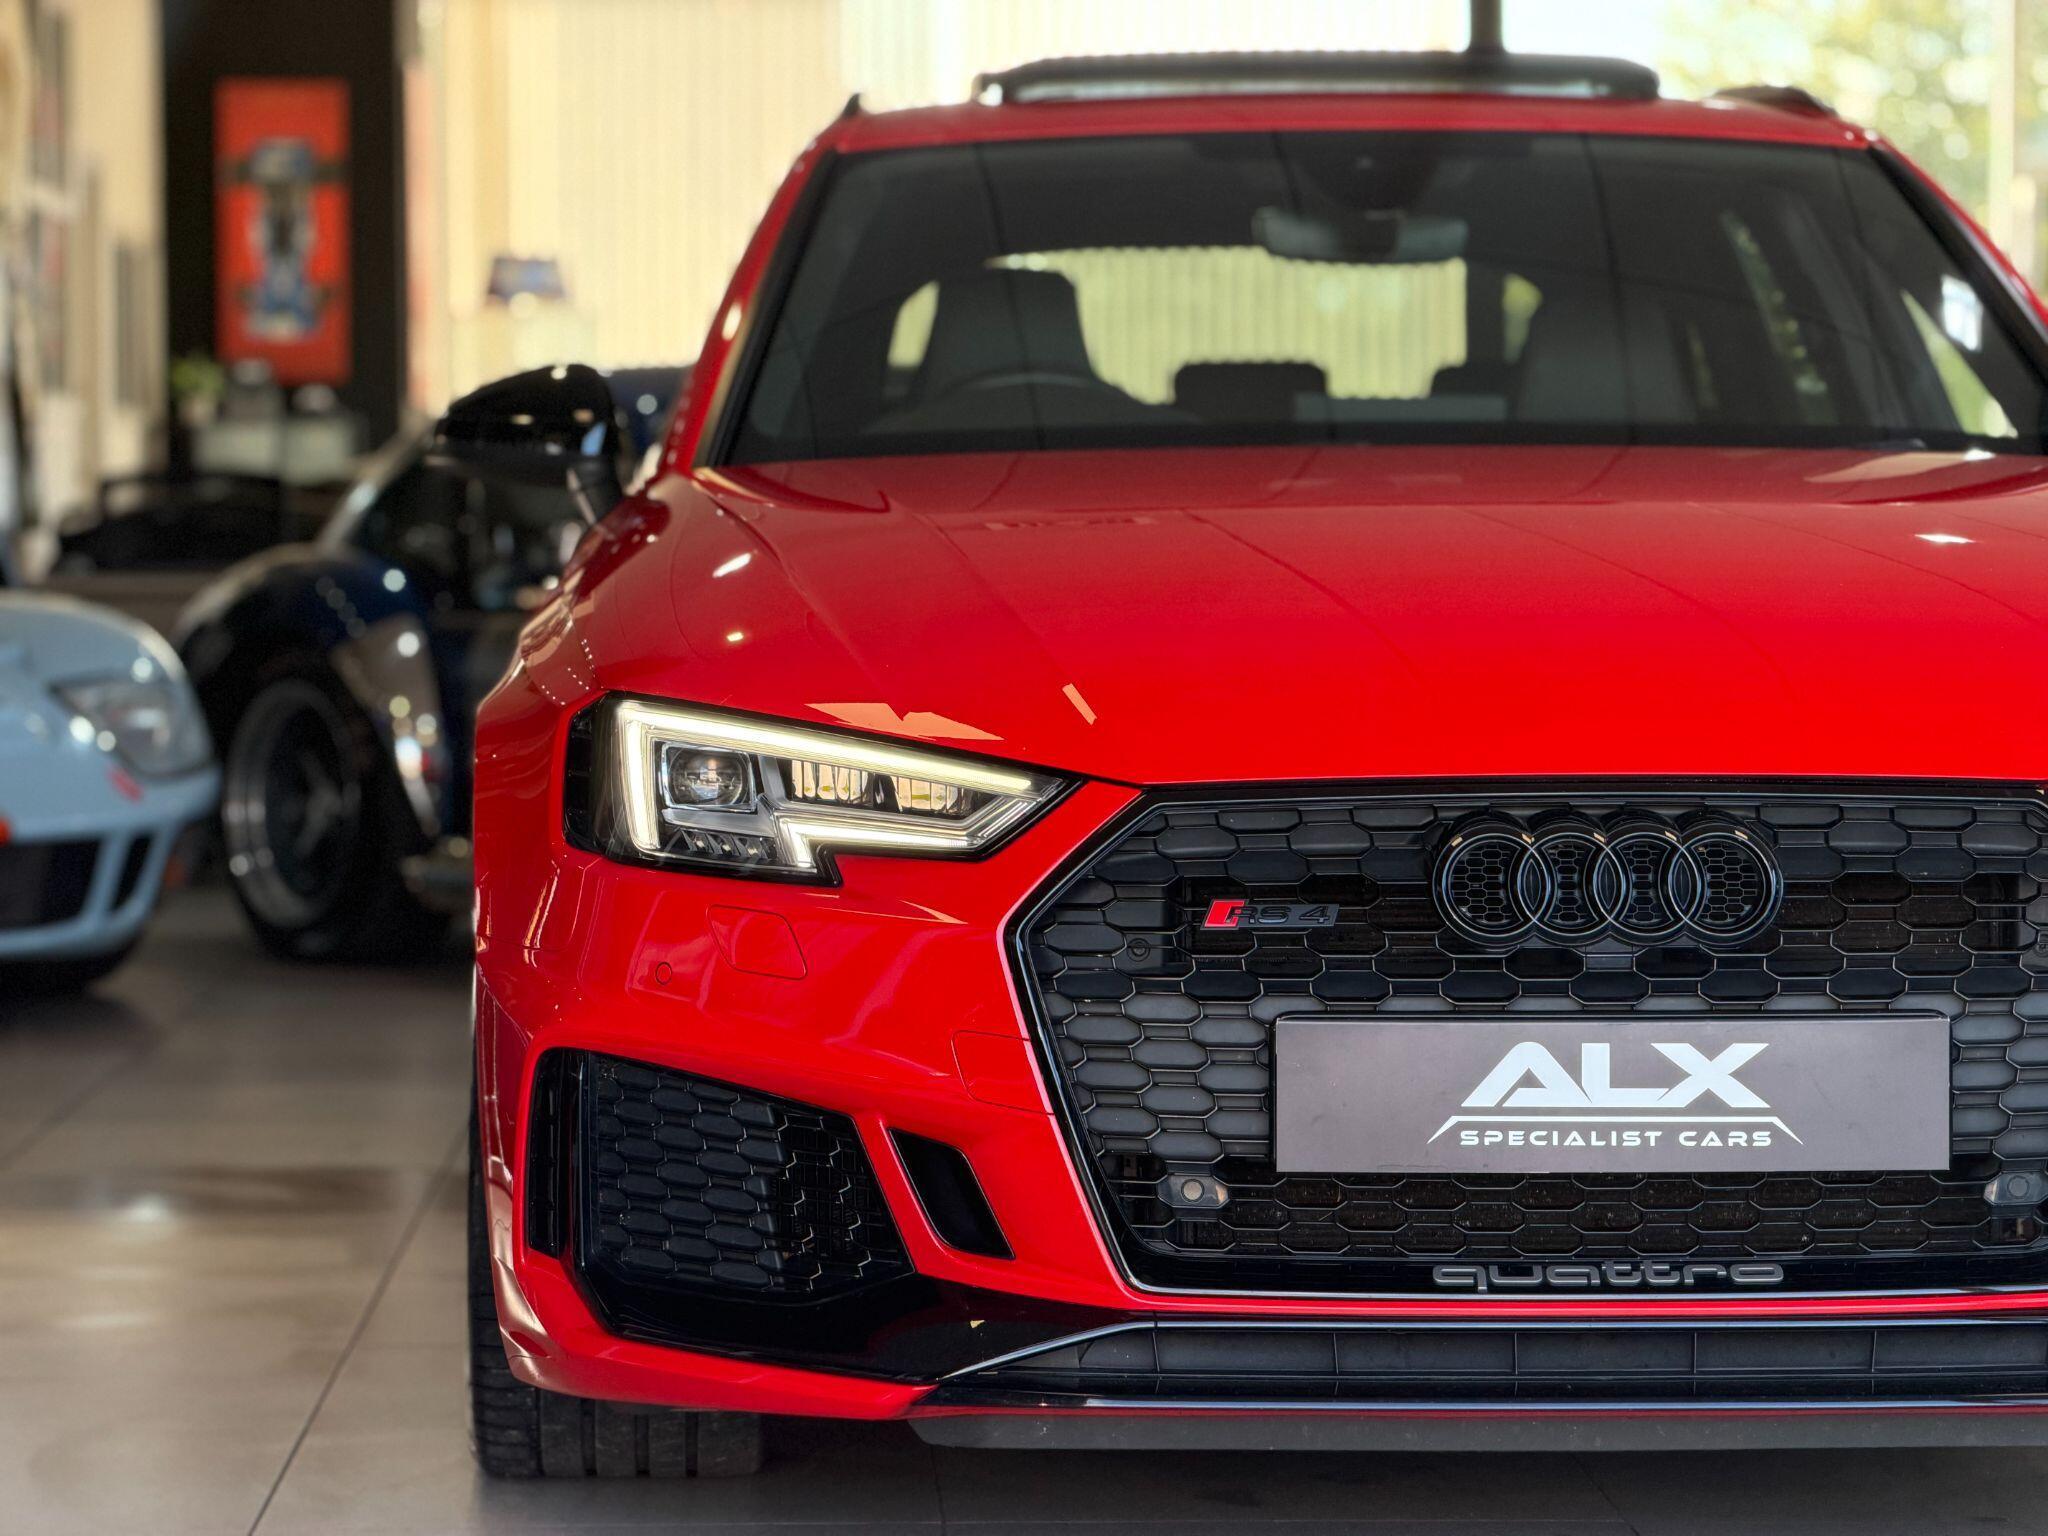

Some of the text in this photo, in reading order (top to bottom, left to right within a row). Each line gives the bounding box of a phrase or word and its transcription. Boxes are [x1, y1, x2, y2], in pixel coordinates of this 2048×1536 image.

[1460, 1041, 1770, 1109] ALX
[1459, 1129, 1773, 1147] SPECIALIST CARS
[1432, 1261, 1785, 1292] quattro
